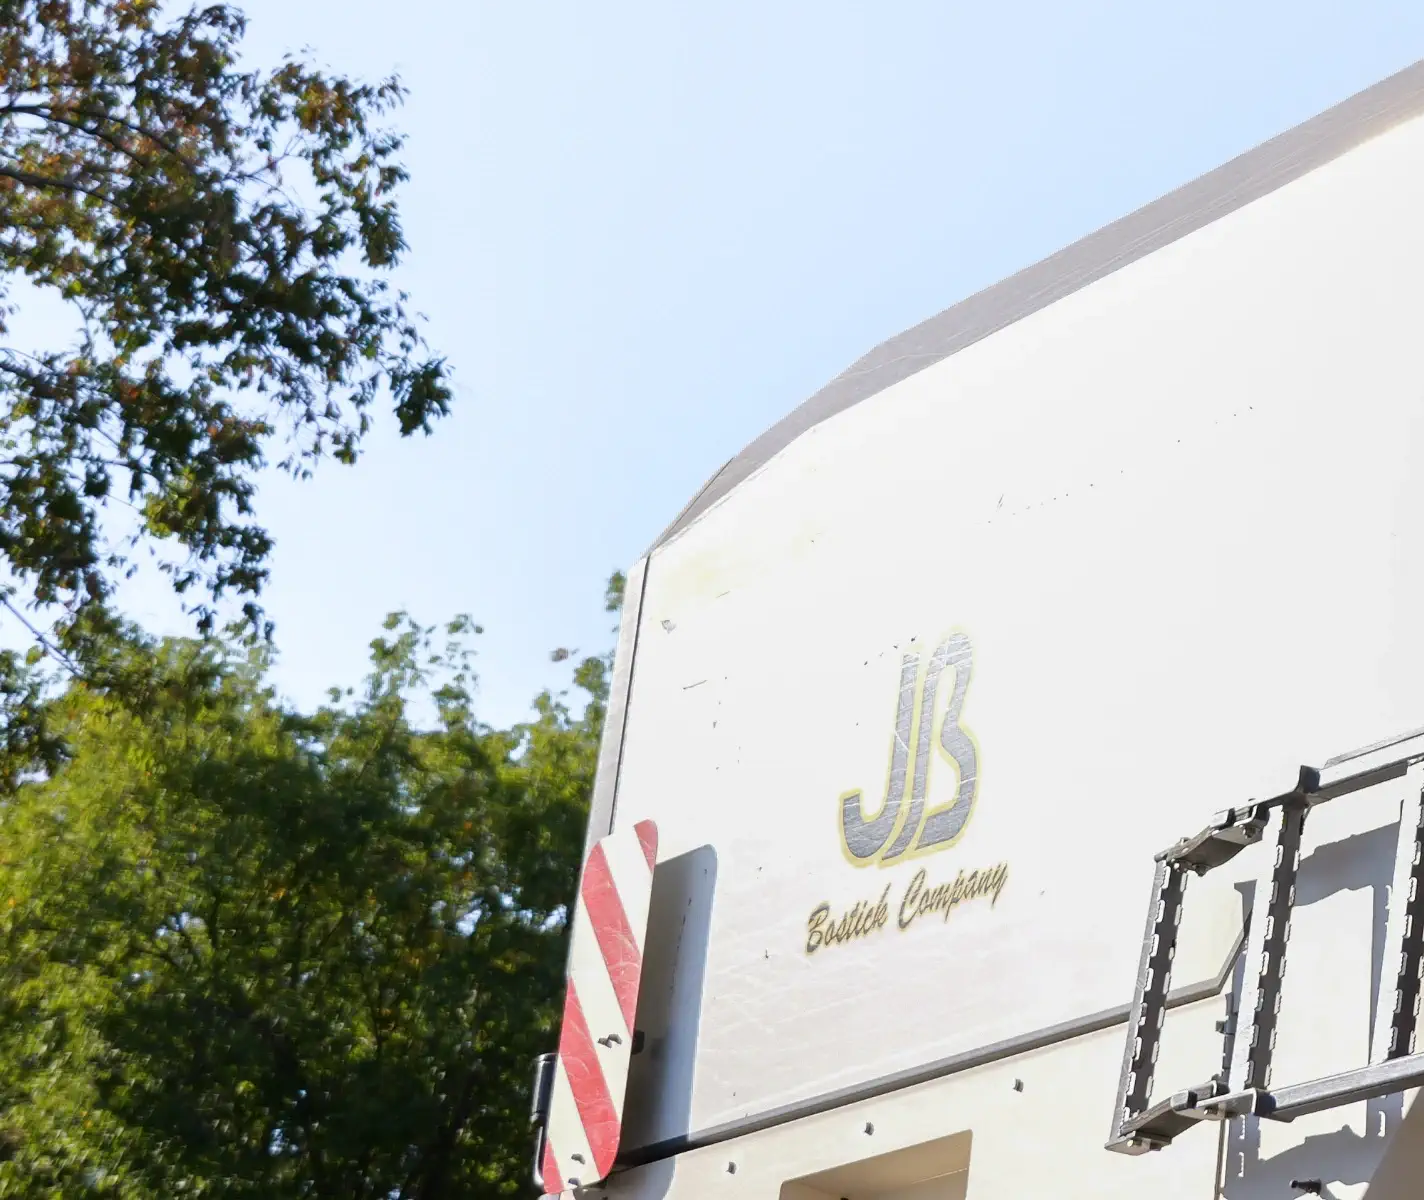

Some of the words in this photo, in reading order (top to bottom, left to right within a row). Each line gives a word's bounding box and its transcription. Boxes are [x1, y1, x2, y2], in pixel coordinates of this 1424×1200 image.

[839, 626, 978, 867] JB
[806, 882, 892, 953] Bostick
[898, 863, 1008, 930] Company
